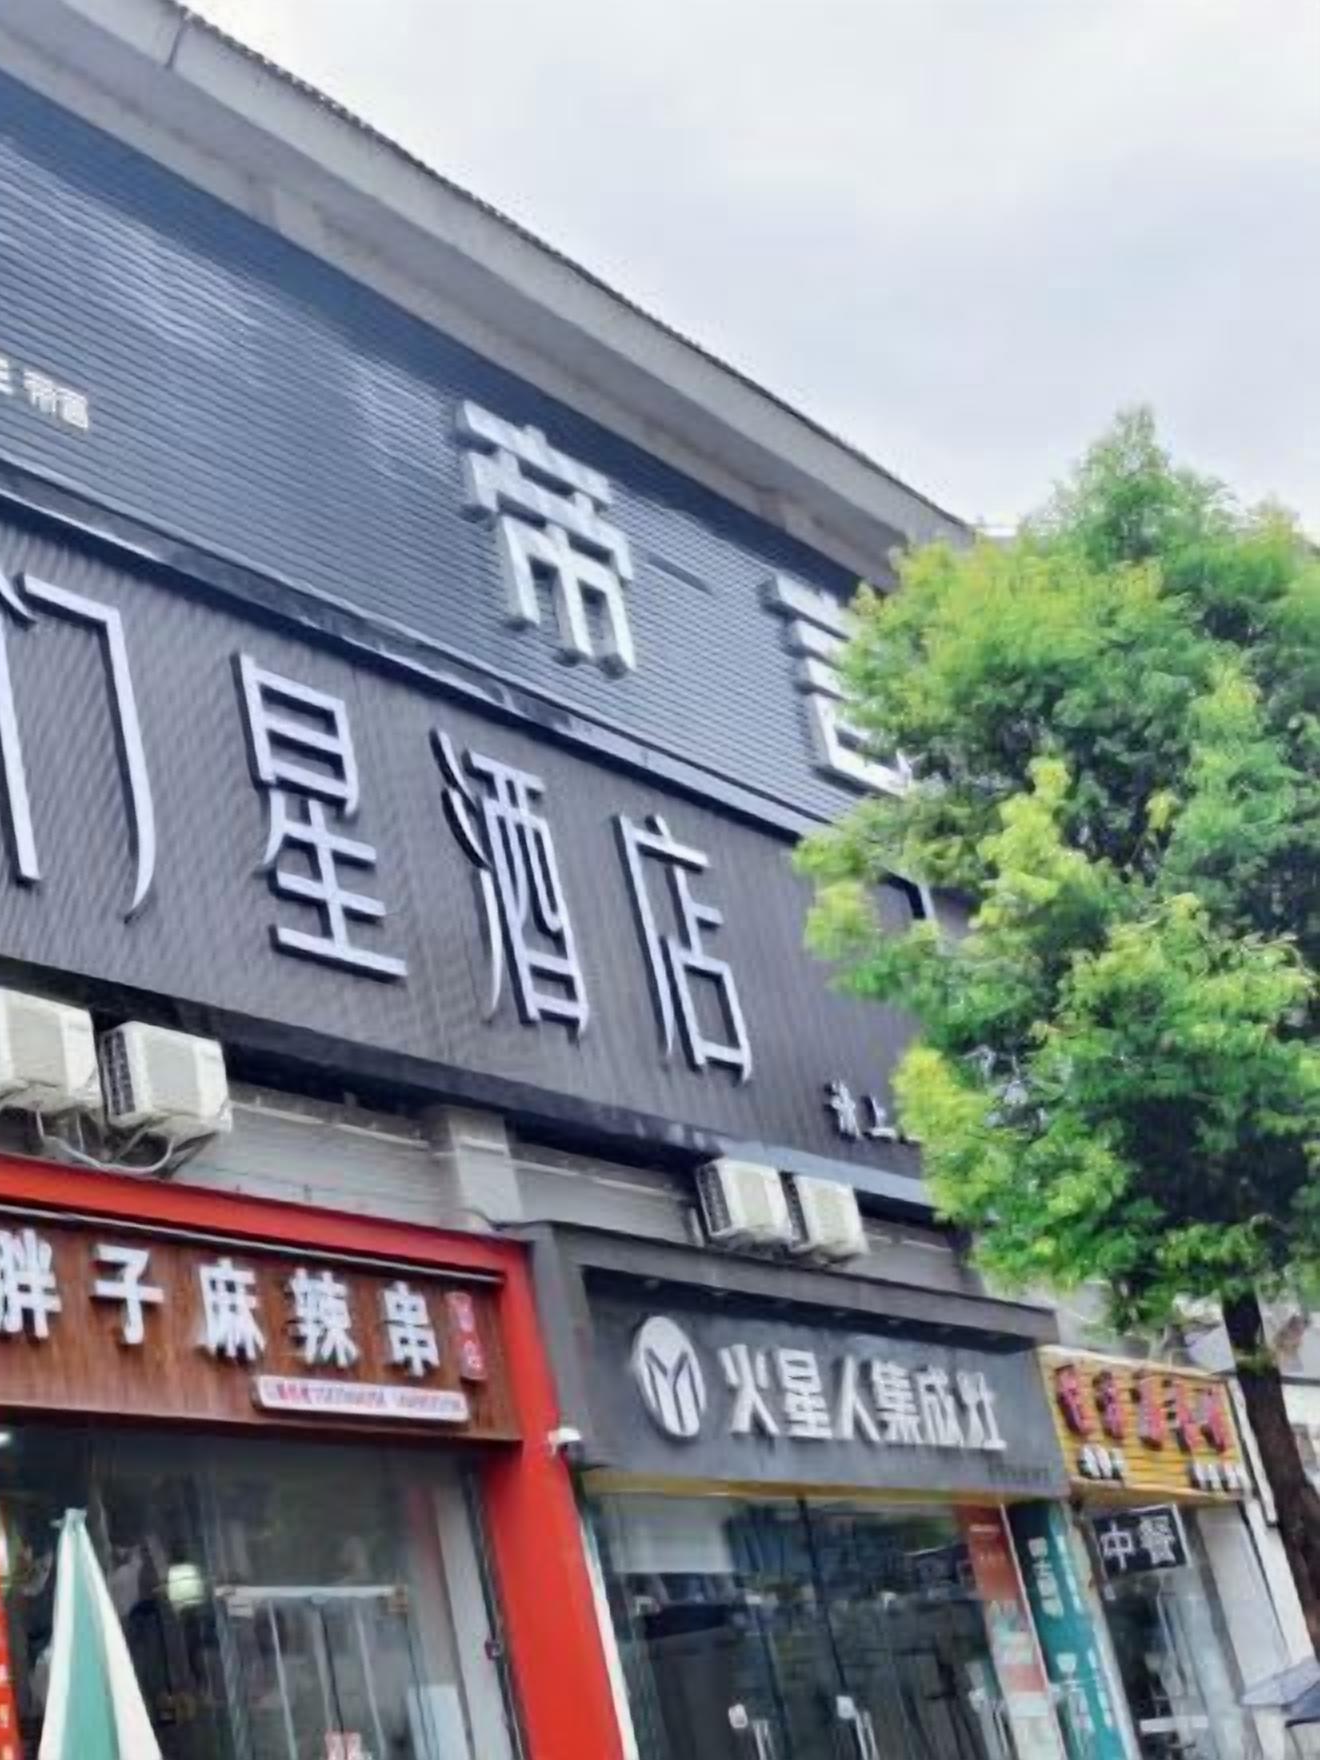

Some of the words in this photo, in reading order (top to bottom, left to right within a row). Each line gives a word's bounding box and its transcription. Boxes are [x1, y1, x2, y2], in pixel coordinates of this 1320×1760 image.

[717, 1343, 1008, 1452] 火星人集成灶
